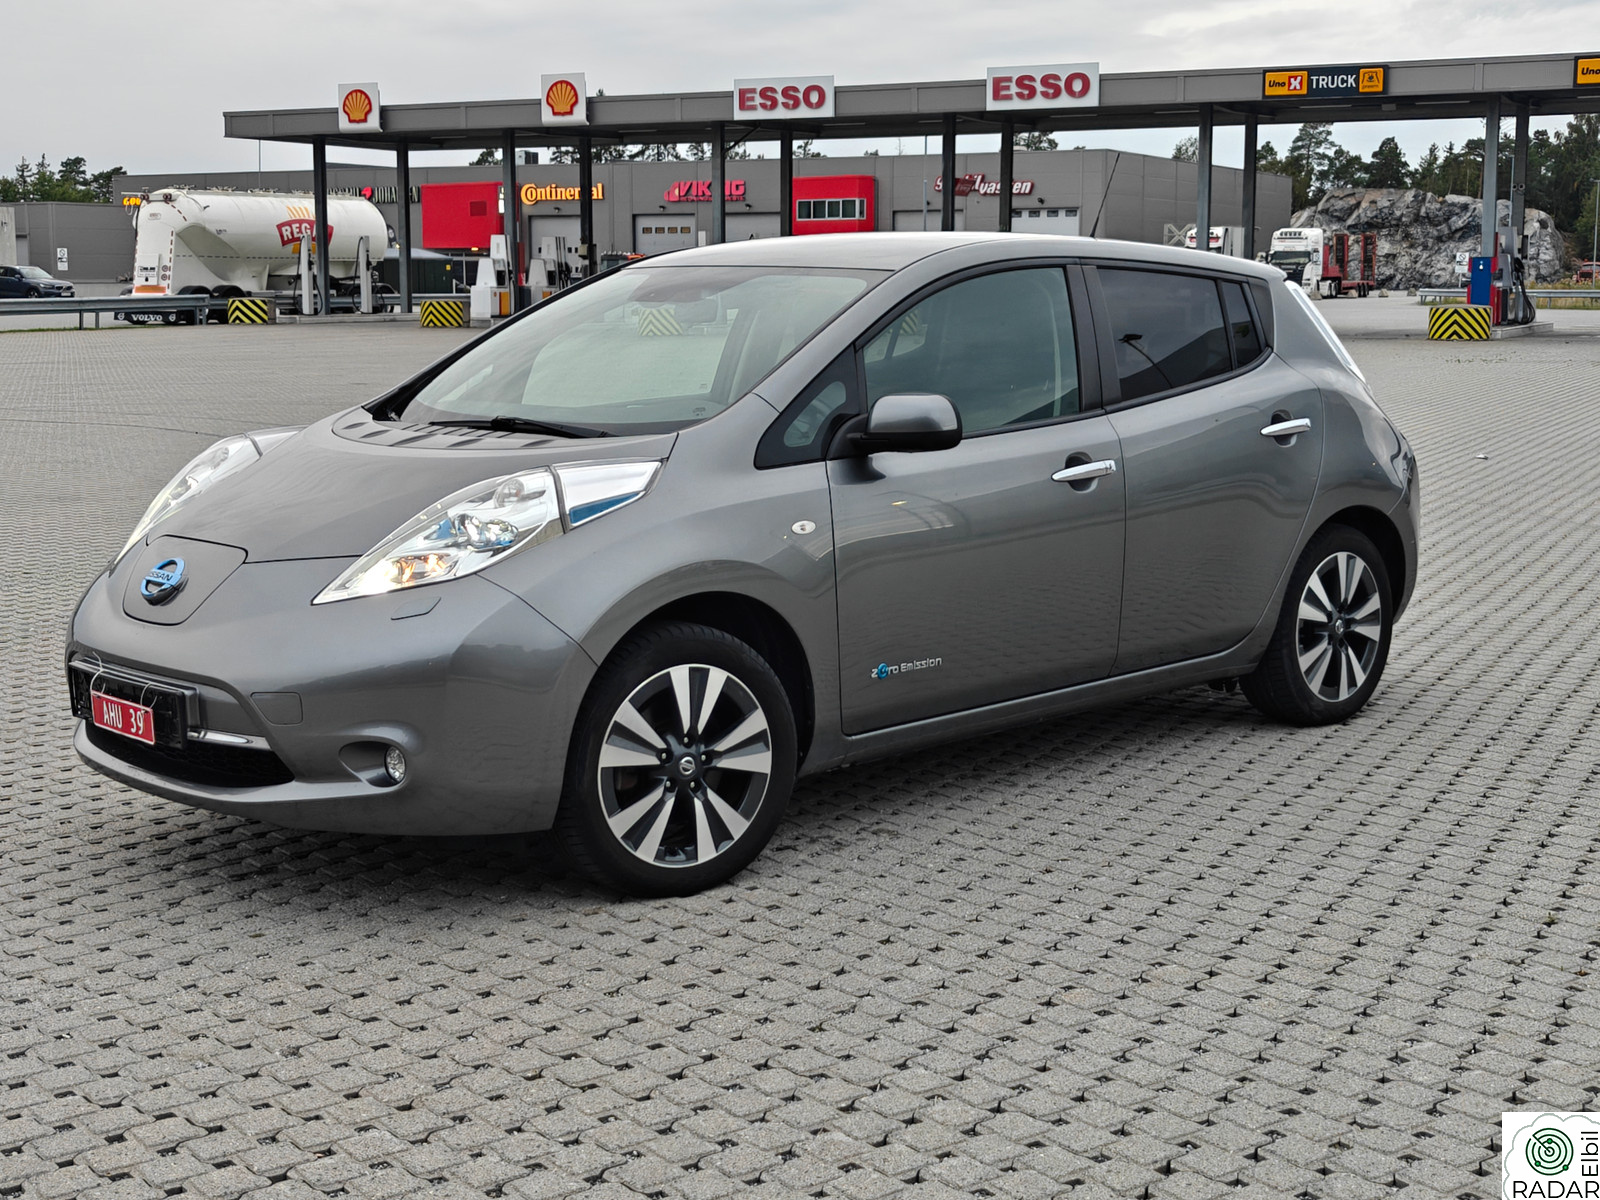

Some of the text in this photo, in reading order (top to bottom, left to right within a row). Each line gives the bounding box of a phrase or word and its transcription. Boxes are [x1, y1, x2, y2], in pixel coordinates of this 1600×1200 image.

[992, 72, 1092, 101] ESSO
[1268, 74, 1357, 91] Uno X TRUCK
[738, 84, 826, 111] ESSO
[520, 182, 604, 206] Continenal
[131, 313, 163, 322] VOLVO
[900, 657, 942, 673] Emission
[103, 700, 144, 735] AHU 39
